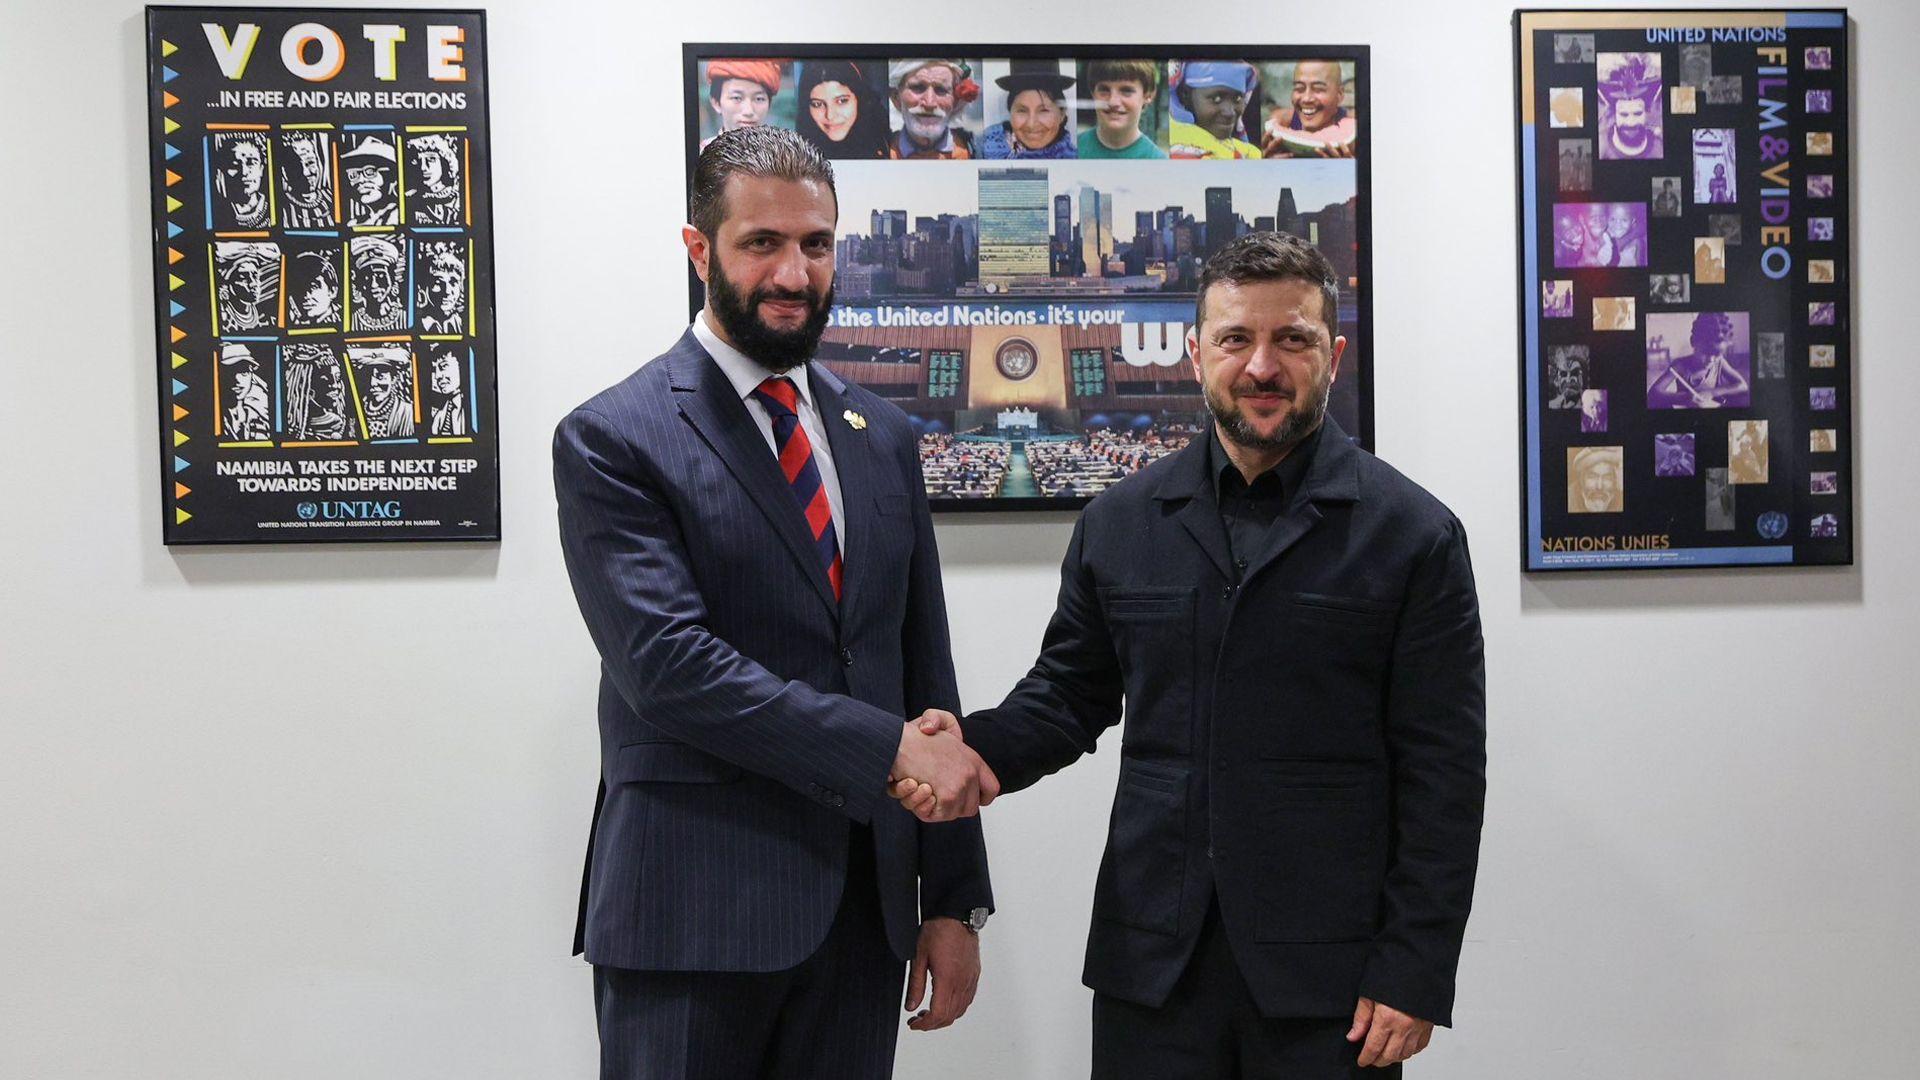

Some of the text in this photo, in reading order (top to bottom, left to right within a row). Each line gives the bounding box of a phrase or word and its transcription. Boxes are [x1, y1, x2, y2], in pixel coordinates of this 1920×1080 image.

[1646, 26, 1787, 43] UNITED NATIONS
[202, 22, 467, 82] VOTE
[244, 91, 285, 108] FREE
[286, 91, 330, 109] AND
[333, 91, 372, 109] FAIR
[374, 92, 467, 110] ELECTIONS
[837, 305, 873, 327] the
[877, 304, 949, 327] United
[953, 304, 1036, 326] Nations
[1047, 304, 1074, 325] it's
[1078, 308, 1125, 330] your
[216, 458, 478, 476] NAMIBIA TAKES THE NEXT STEP
[236, 475, 457, 493] TOWARDS INDEPENDENCE
[321, 500, 401, 519] UNTAG
[257, 521, 280, 529] UNITED
[281, 521, 308, 529] NATIONS
[309, 520, 345, 528] TRANSITION
[346, 520, 381, 528] ASSISTANCE
[382, 520, 404, 528] GROUP
[413, 519, 441, 527] NAMIBIA
[1541, 534, 1670, 552] NATIONS UNIES
